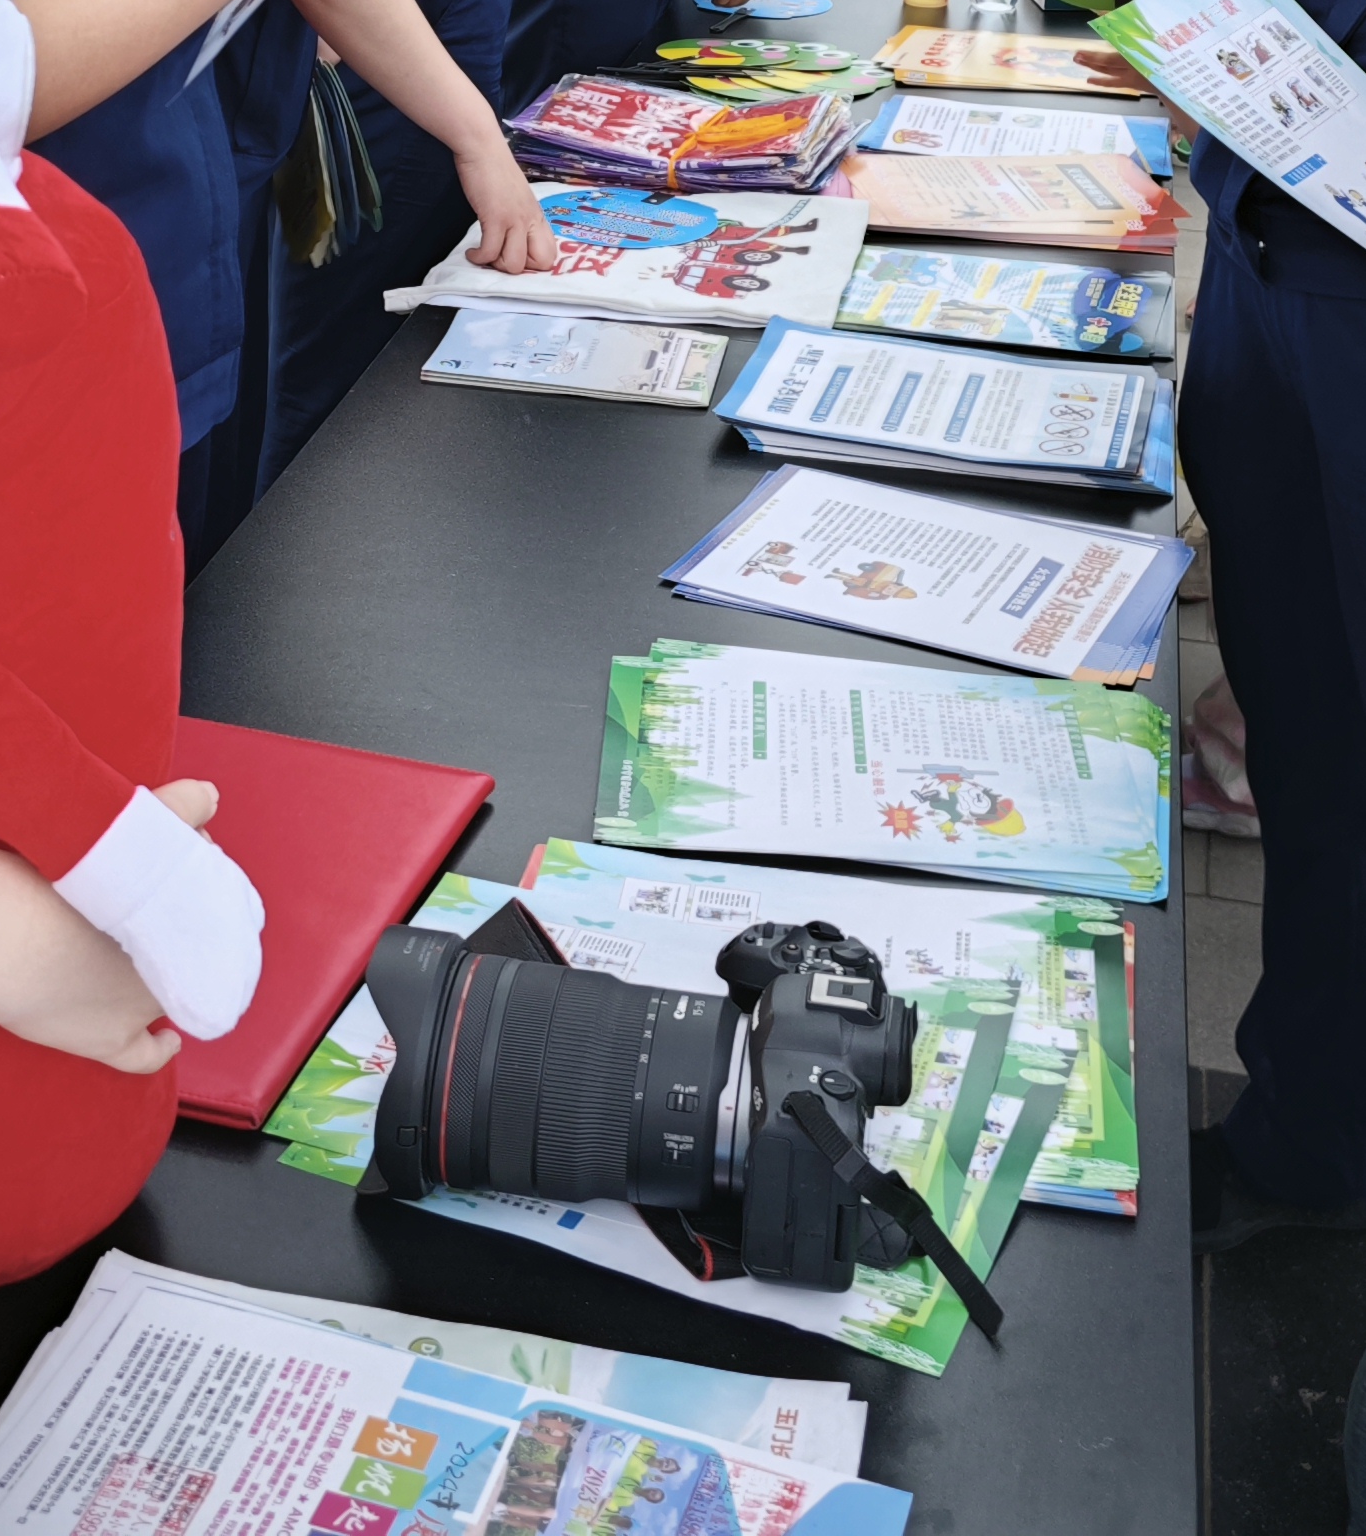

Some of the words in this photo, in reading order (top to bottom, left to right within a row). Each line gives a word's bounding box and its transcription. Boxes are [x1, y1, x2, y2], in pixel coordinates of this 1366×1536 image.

[870, 759, 885, 796] 当心触电
[672, 994, 690, 1021] Canon
[692, 999, 706, 1016] 15-35
[639, 1053, 649, 1064] 20
[635, 1090, 644, 1101] 15
[302, 1406, 357, 1493] 我们是专业的
[331, 1419, 420, 1525] 扬帆起
[425, 1441, 476, 1509] 2024年
